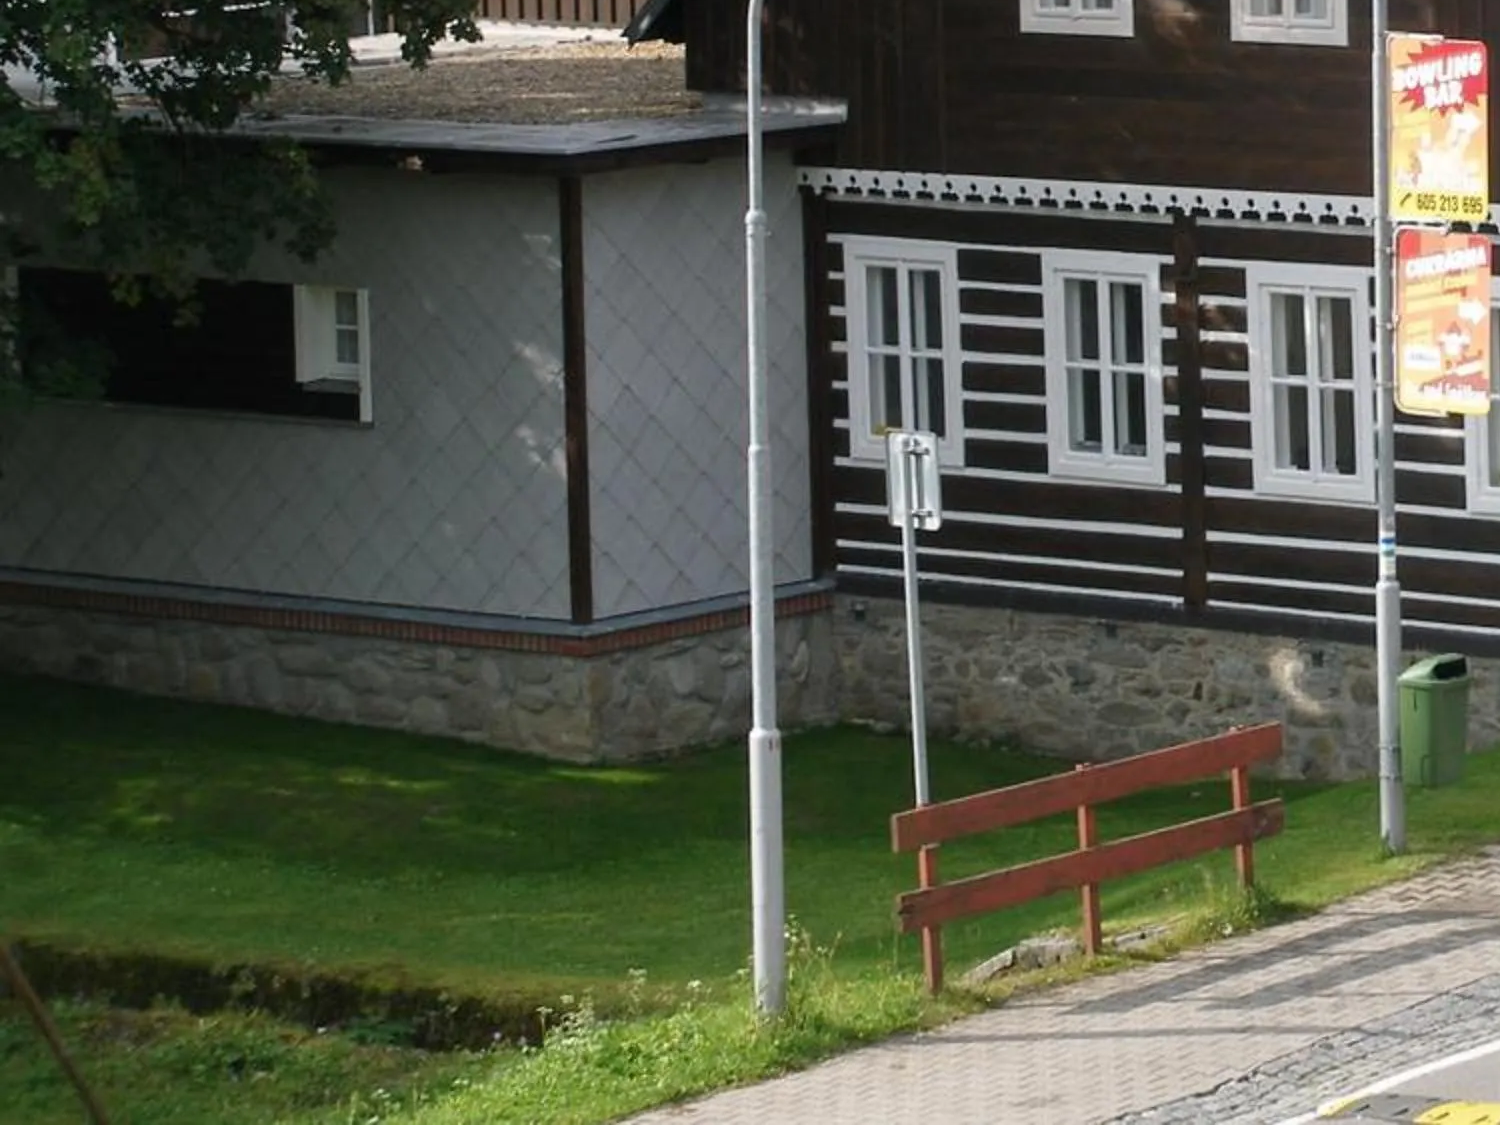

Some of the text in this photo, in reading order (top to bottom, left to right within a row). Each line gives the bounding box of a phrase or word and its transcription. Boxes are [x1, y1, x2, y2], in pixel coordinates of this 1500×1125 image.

[1392, 53, 1482, 90] BOWLING
[1424, 81, 1463, 108] BAR
[1439, 194, 1459, 213] 213
